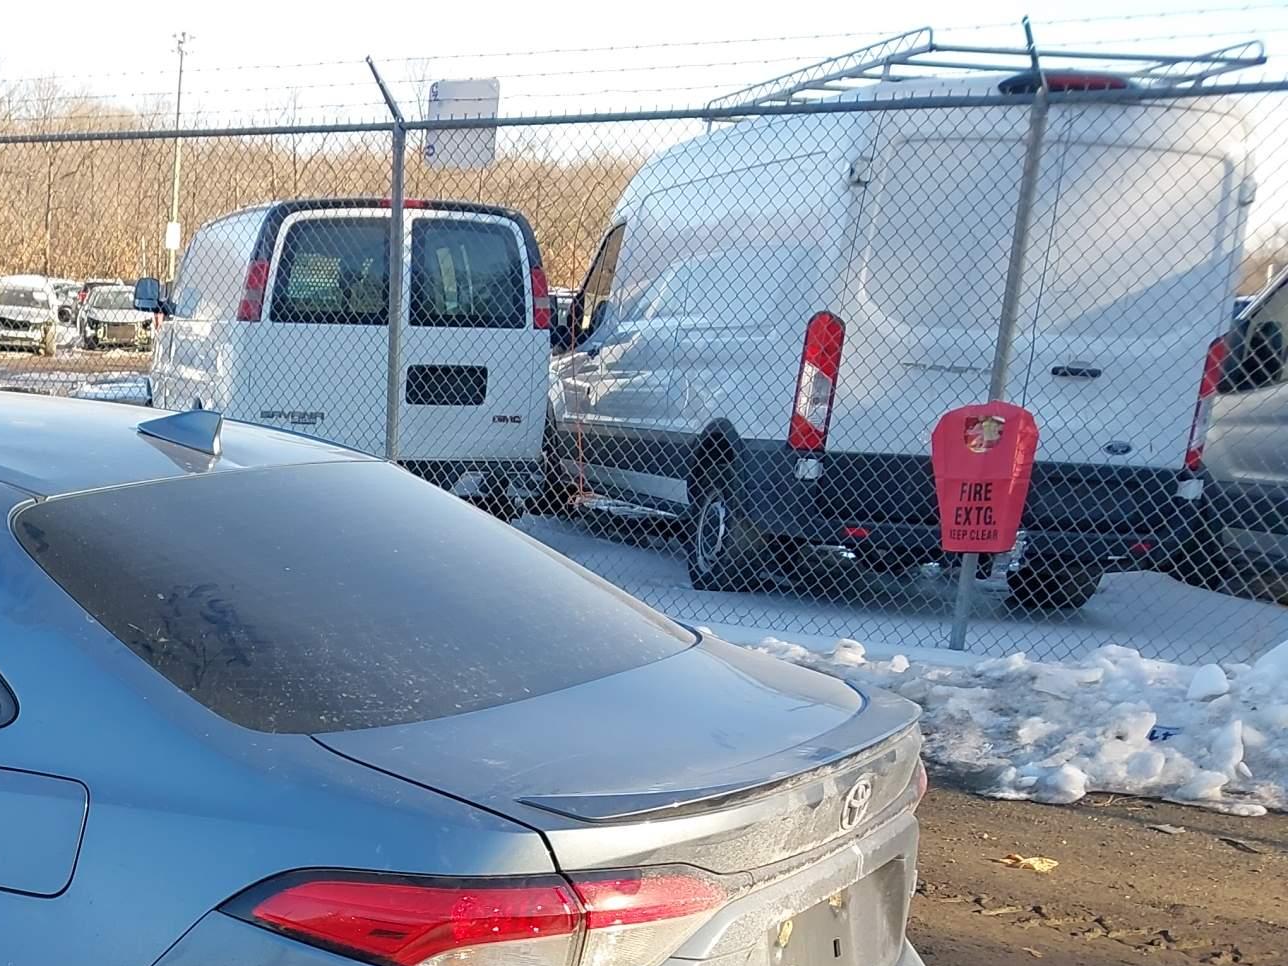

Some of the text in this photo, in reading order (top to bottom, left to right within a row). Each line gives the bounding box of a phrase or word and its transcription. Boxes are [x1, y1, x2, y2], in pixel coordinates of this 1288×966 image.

[959, 482, 993, 501] FIRE
[954, 506, 996, 526] EXTG.
[969, 529, 998, 540] CLEAR
